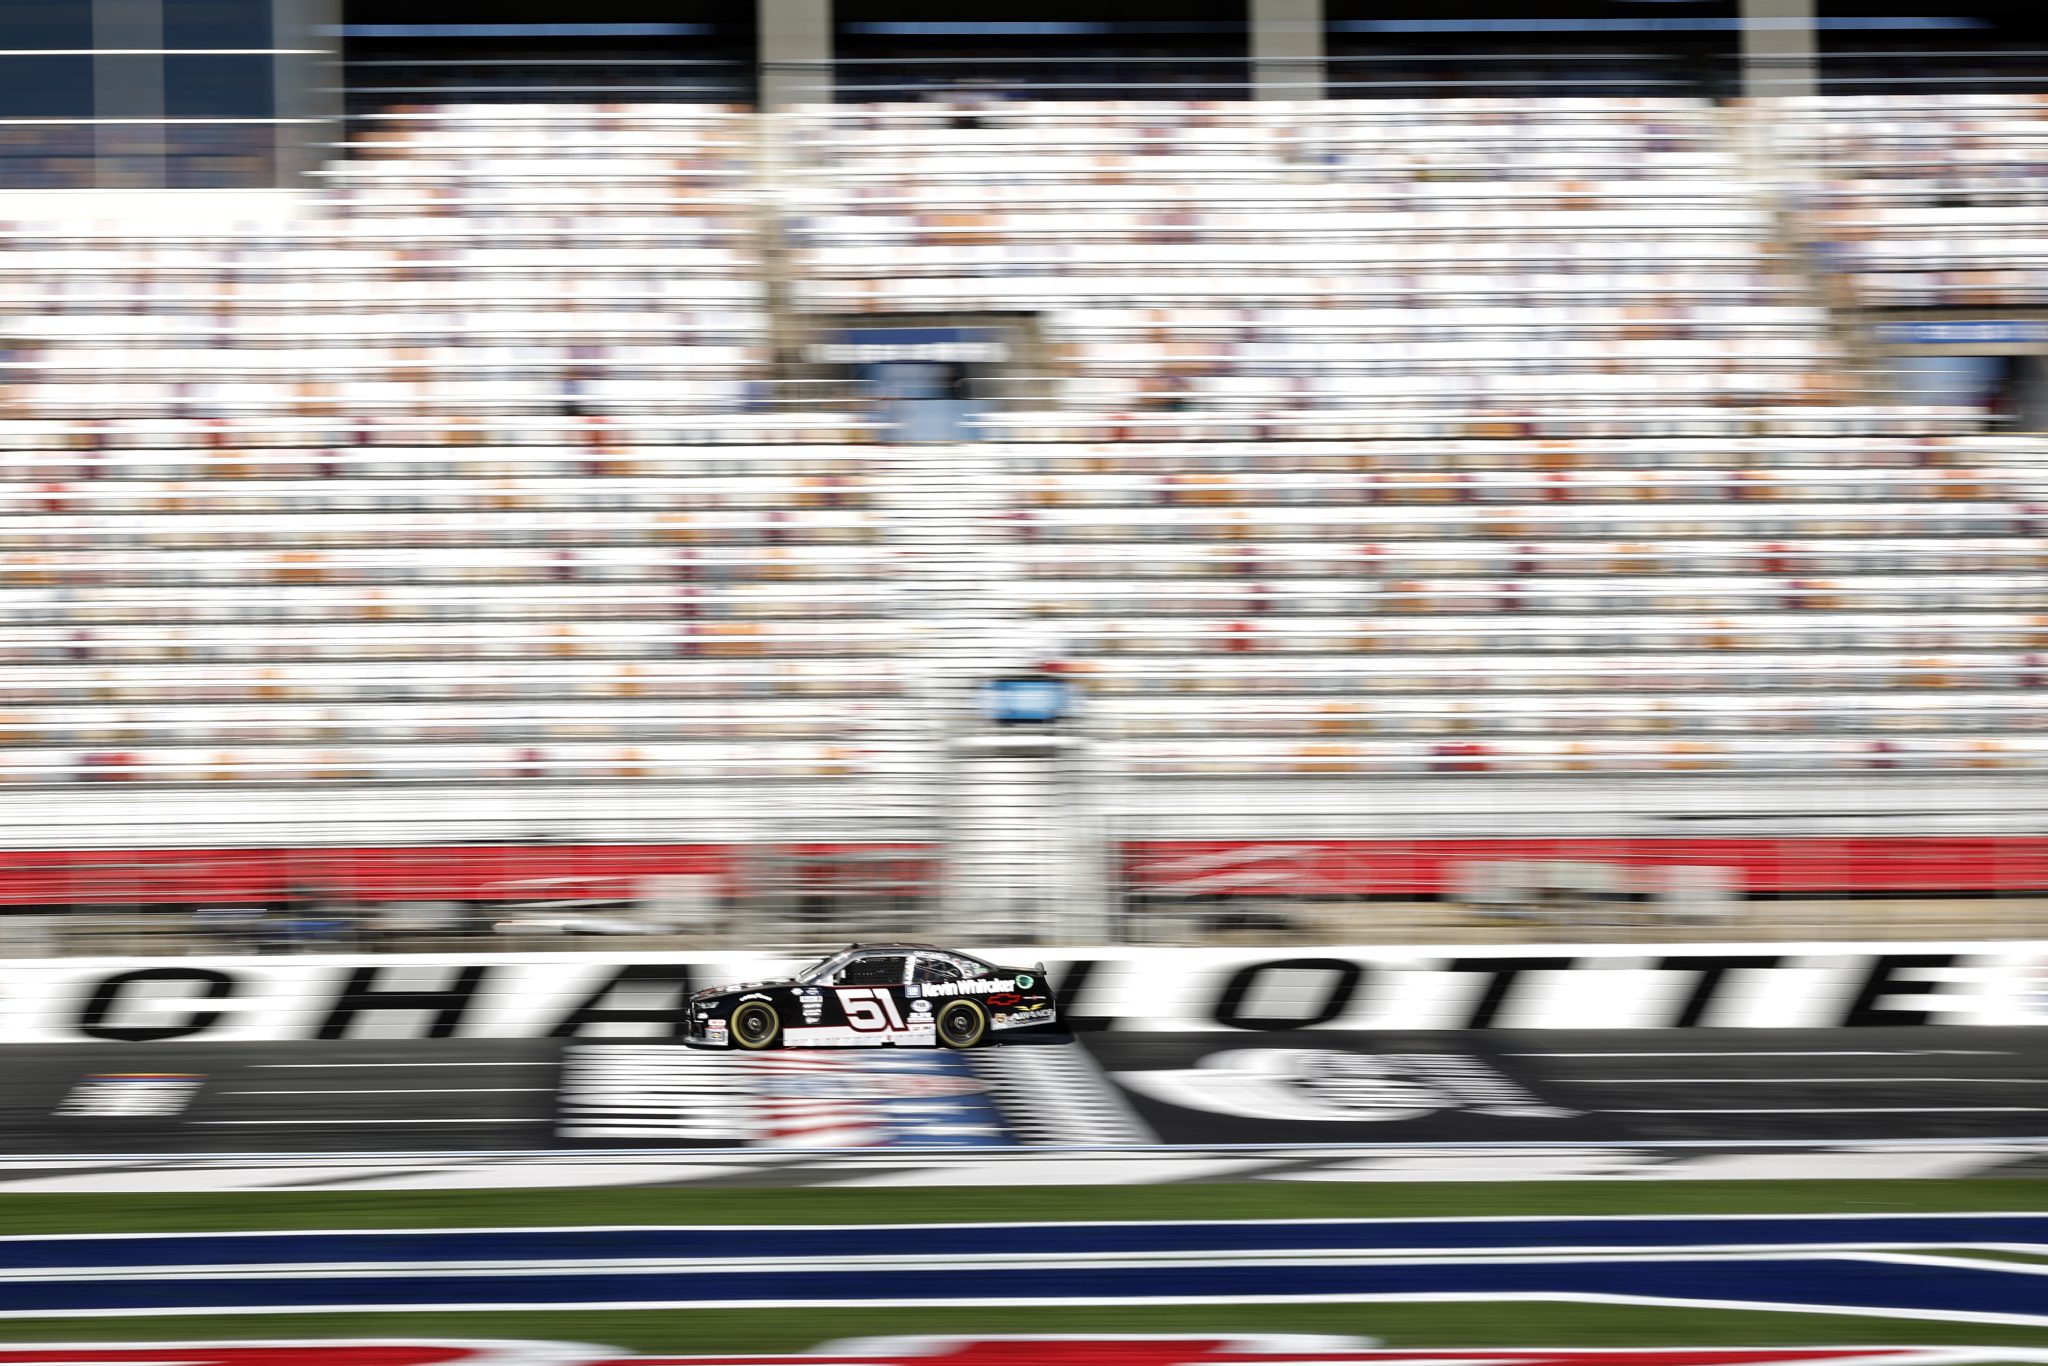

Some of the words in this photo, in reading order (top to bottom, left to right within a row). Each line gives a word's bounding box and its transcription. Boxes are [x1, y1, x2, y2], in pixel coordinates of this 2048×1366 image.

[72, 954, 1976, 1041] CHALOTTE
[922, 981, 959, 997] Kevin
[957, 977, 1016, 995] Whitaker
[835, 988, 908, 1032] 51
